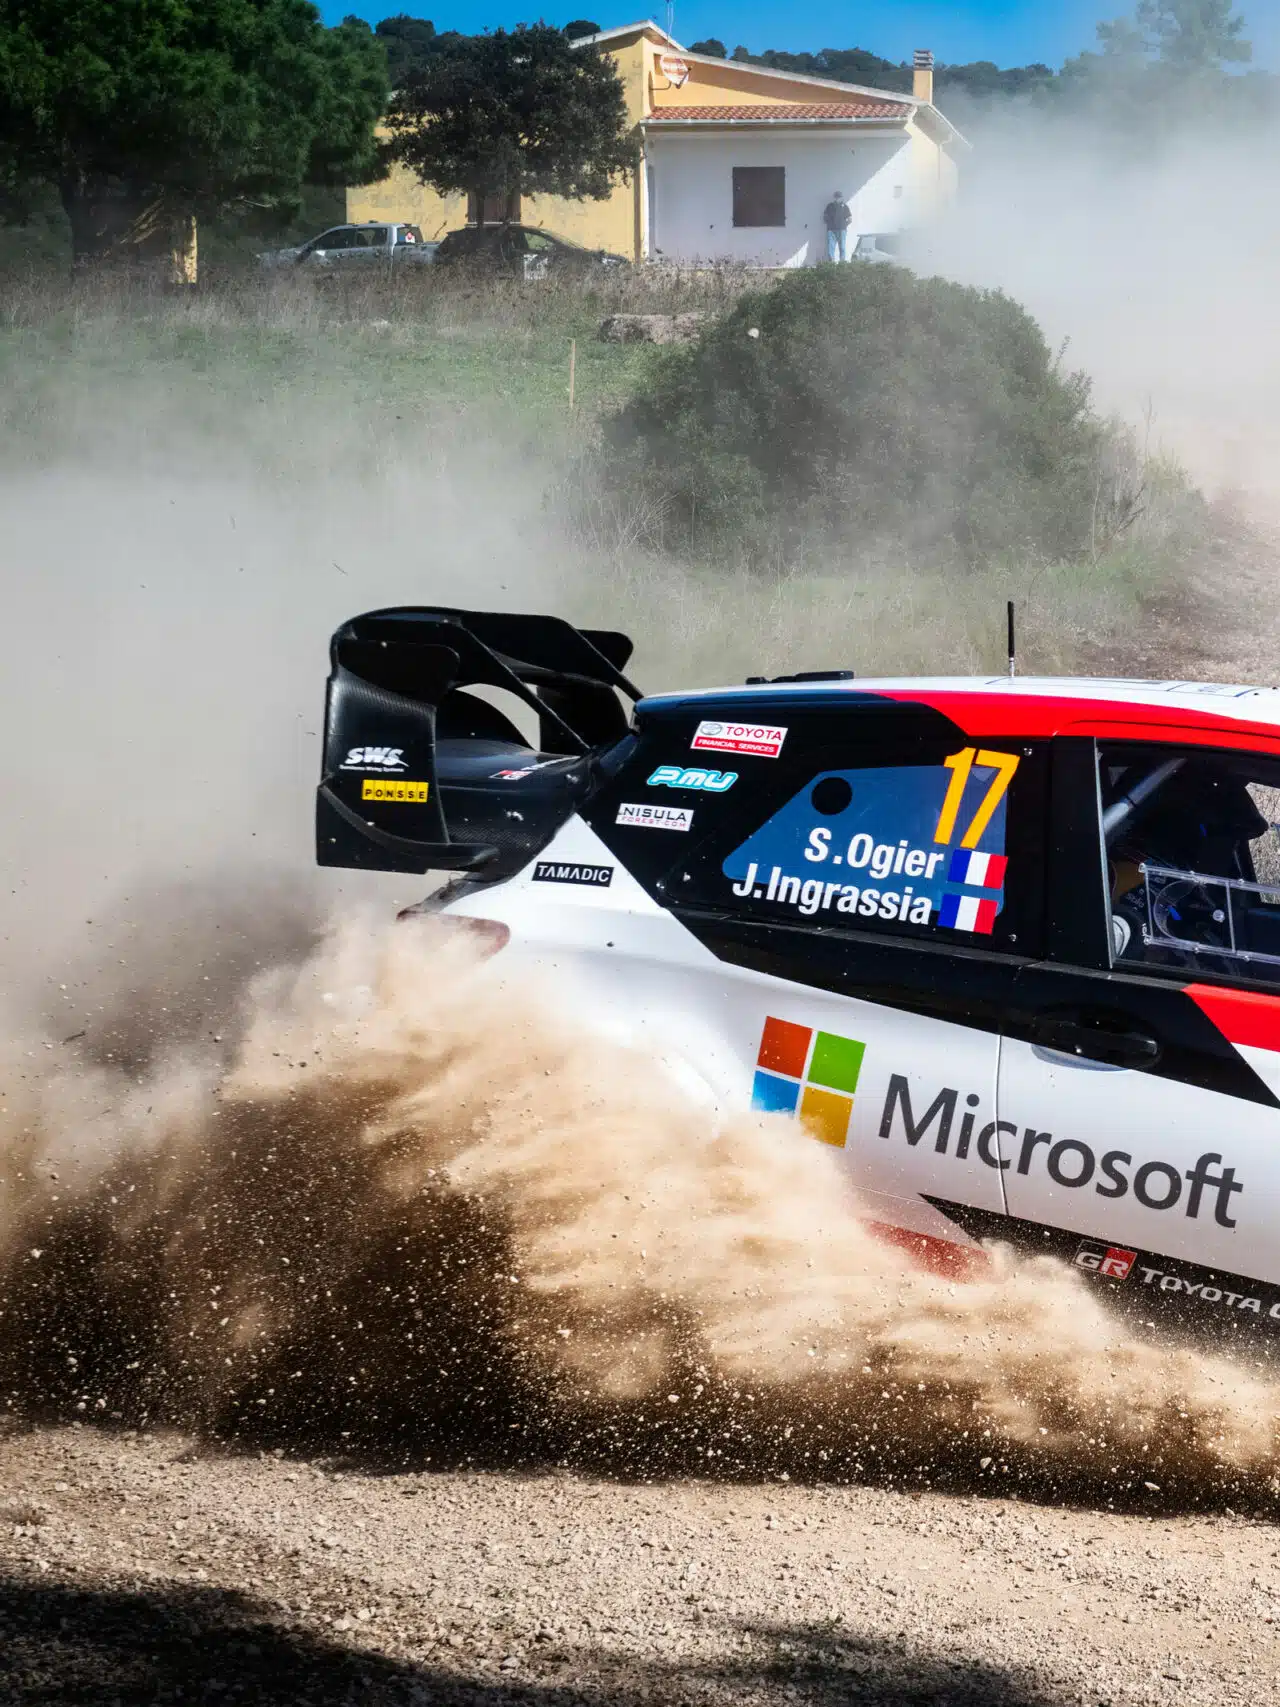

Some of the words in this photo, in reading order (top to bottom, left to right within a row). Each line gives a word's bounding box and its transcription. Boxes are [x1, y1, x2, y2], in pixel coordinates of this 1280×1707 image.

[726, 726, 782, 741] TOYOTA
[698, 738, 737, 748] FINANCIAL
[738, 743, 775, 753] SERVICES
[344, 746, 409, 767] SWS
[365, 788, 425, 799] PONSSE
[934, 747, 1020, 849] 17
[623, 807, 687, 822] NISULA
[538, 865, 610, 882] TAMADIC
[732, 863, 933, 925] J.Ingrassia
[878, 1073, 1244, 1229] Microsoft
[1074, 1249, 1130, 1279] GR
[1138, 1267, 1262, 1313] TOYOTA
